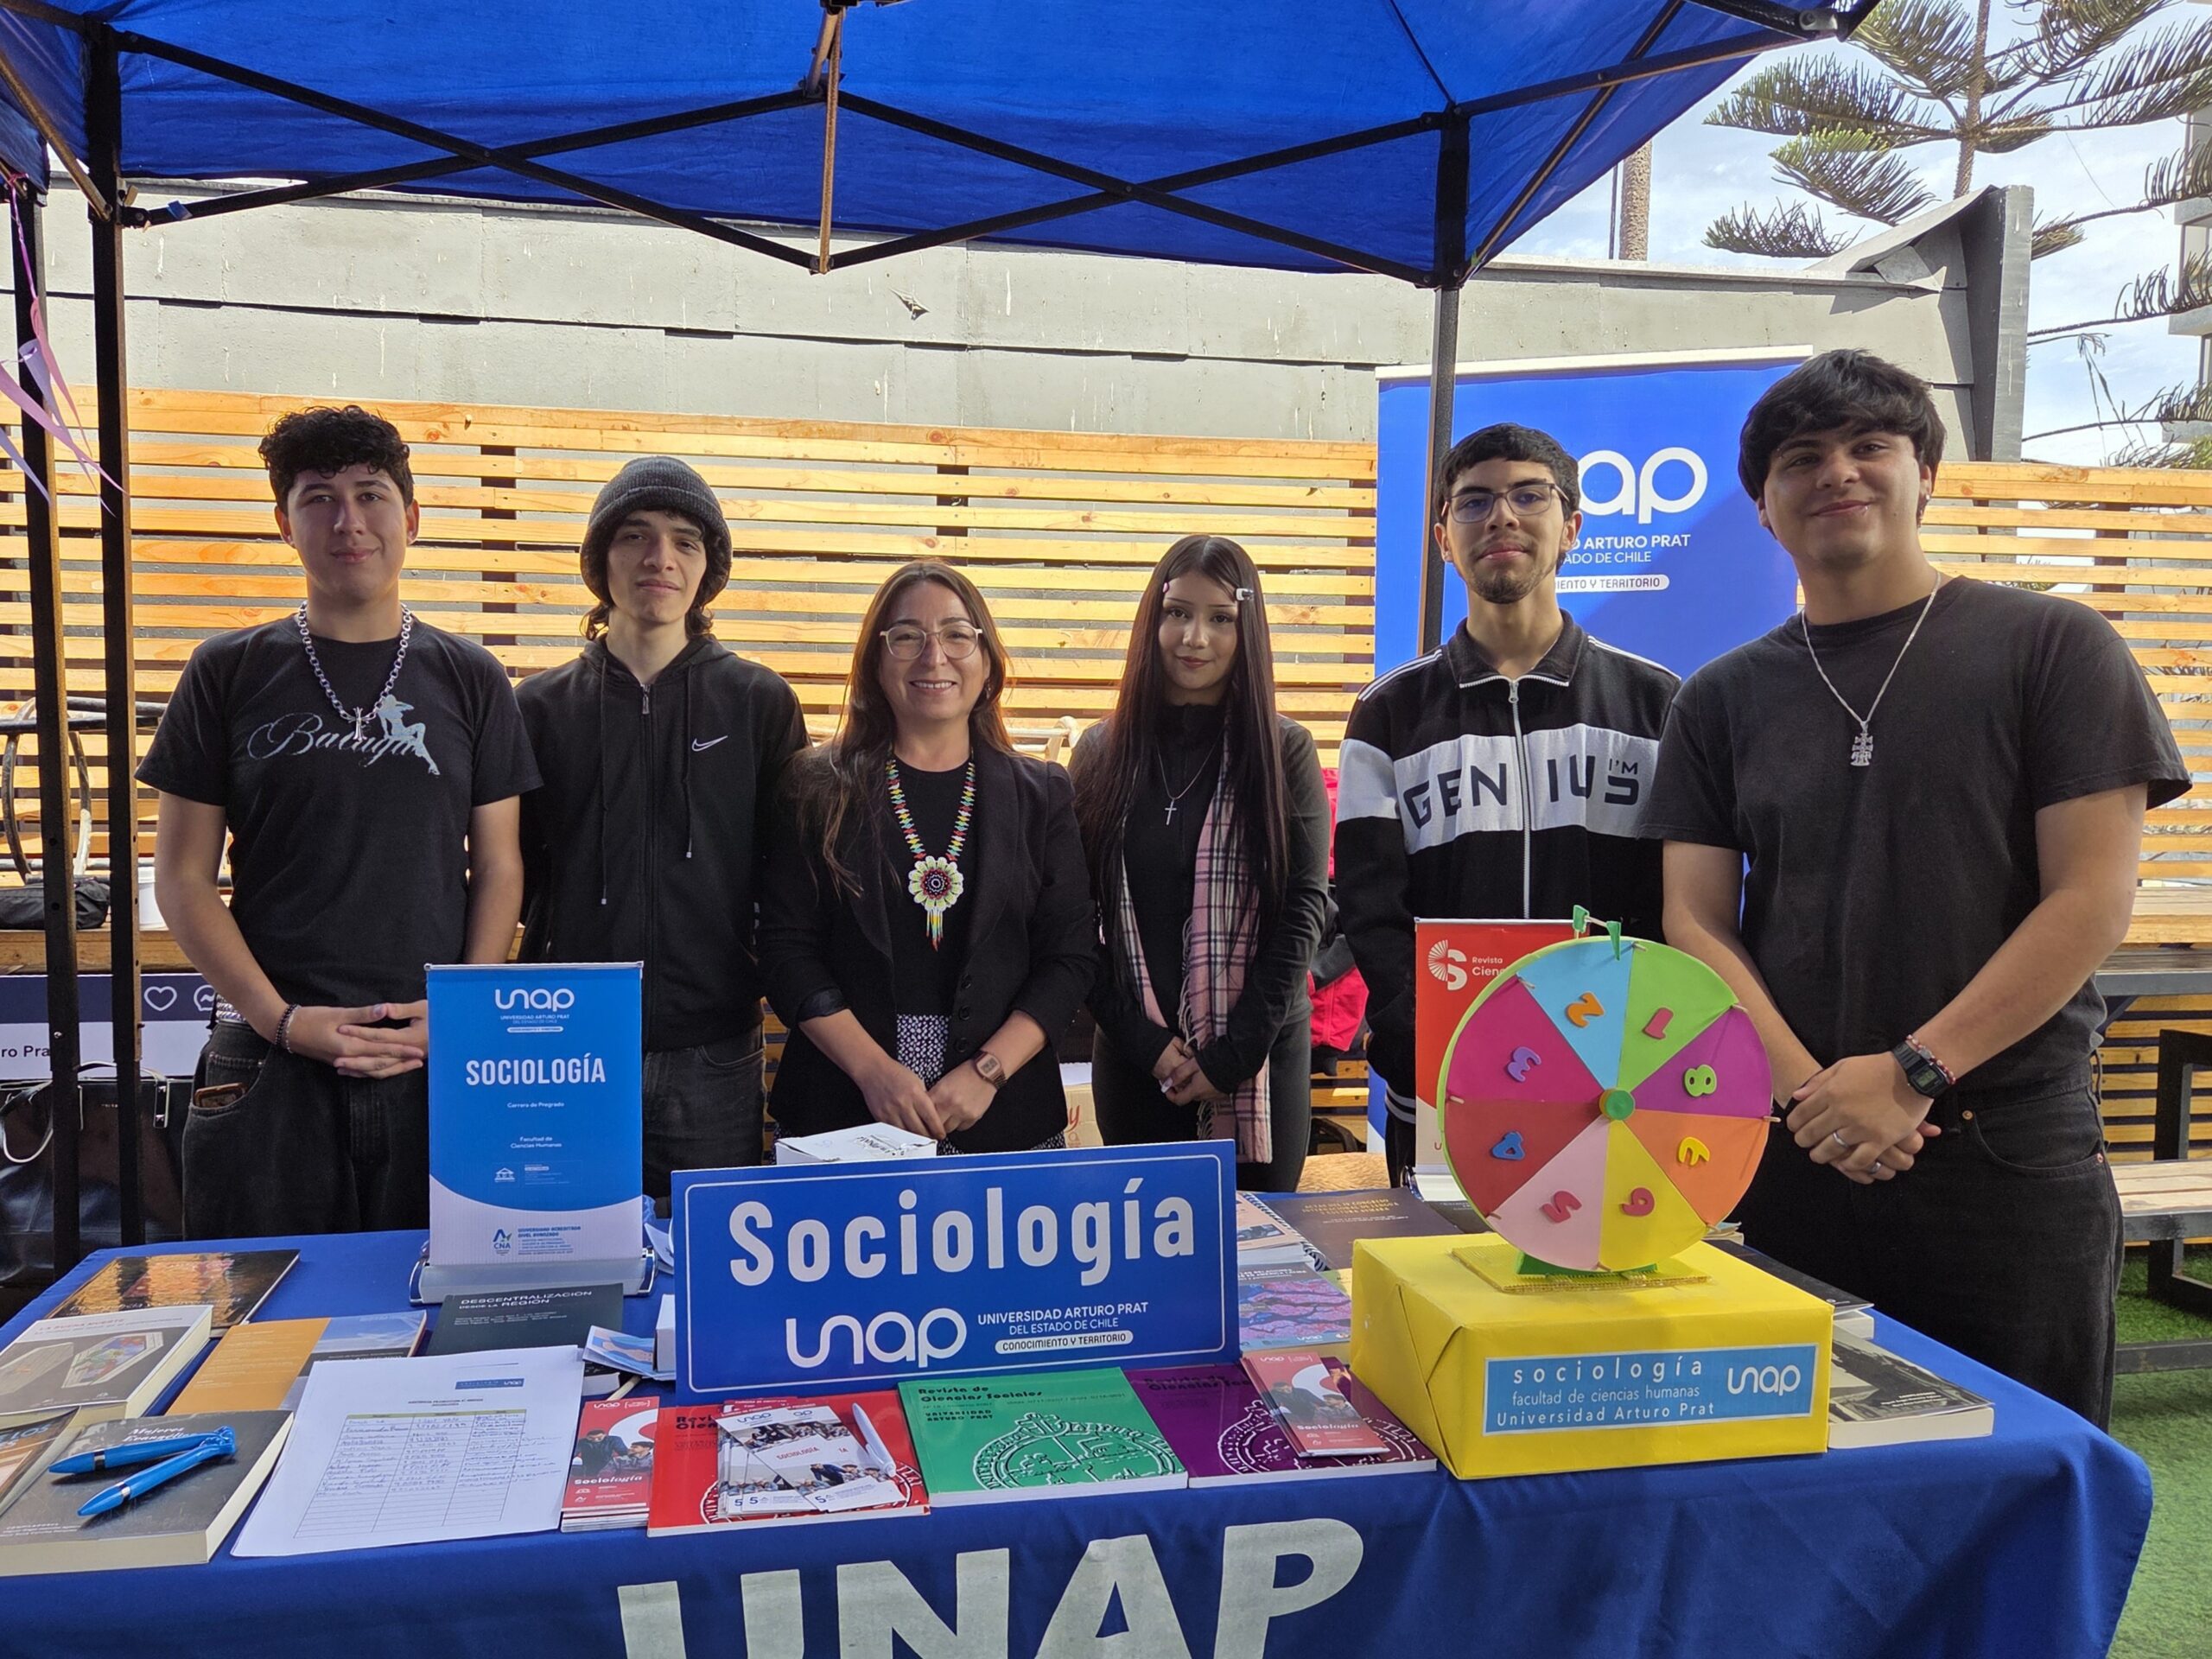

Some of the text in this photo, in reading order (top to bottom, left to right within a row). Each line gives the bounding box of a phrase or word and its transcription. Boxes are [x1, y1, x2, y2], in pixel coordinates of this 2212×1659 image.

[1584, 536, 1648, 550] ARTURO
[1651, 534, 1690, 548] PRAT
[1564, 551, 1651, 564] ADO DE CHILE
[1589, 579, 1597, 589] Y
[1599, 577, 1660, 588] TERRITORIO
[495, 988, 575, 1012] unap
[466, 1052, 606, 1086] SOCIOLOGÍA
[1684, 1064, 1717, 1097] 8
[1491, 1131, 1525, 1160] 4
[728, 1179, 1195, 1287] Sociología
[978, 1302, 1148, 1325] UNIVERSIDAD ARTURO PRAT
[786, 1307, 967, 1368] unap
[1009, 1318, 1118, 1335] DEL ESTADO DE CHILE
[1002, 1333, 1126, 1351] CONOCIMIENTO Y TERRITORIO
[1514, 1356, 1702, 1383] sociología
[1728, 1365, 1802, 1396] unap
[918, 1386, 968, 1395] Revista
[1512, 1385, 1700, 1407] facultad de ciencias humanas
[677, 1414, 713, 1423] Revi
[1497, 1402, 1714, 1427] Universidad Arturo Prat
[575, 1475, 643, 1484] Sociología
[815, 1495, 827, 1503] 5
[618, 1518, 1363, 1659] UNAP
